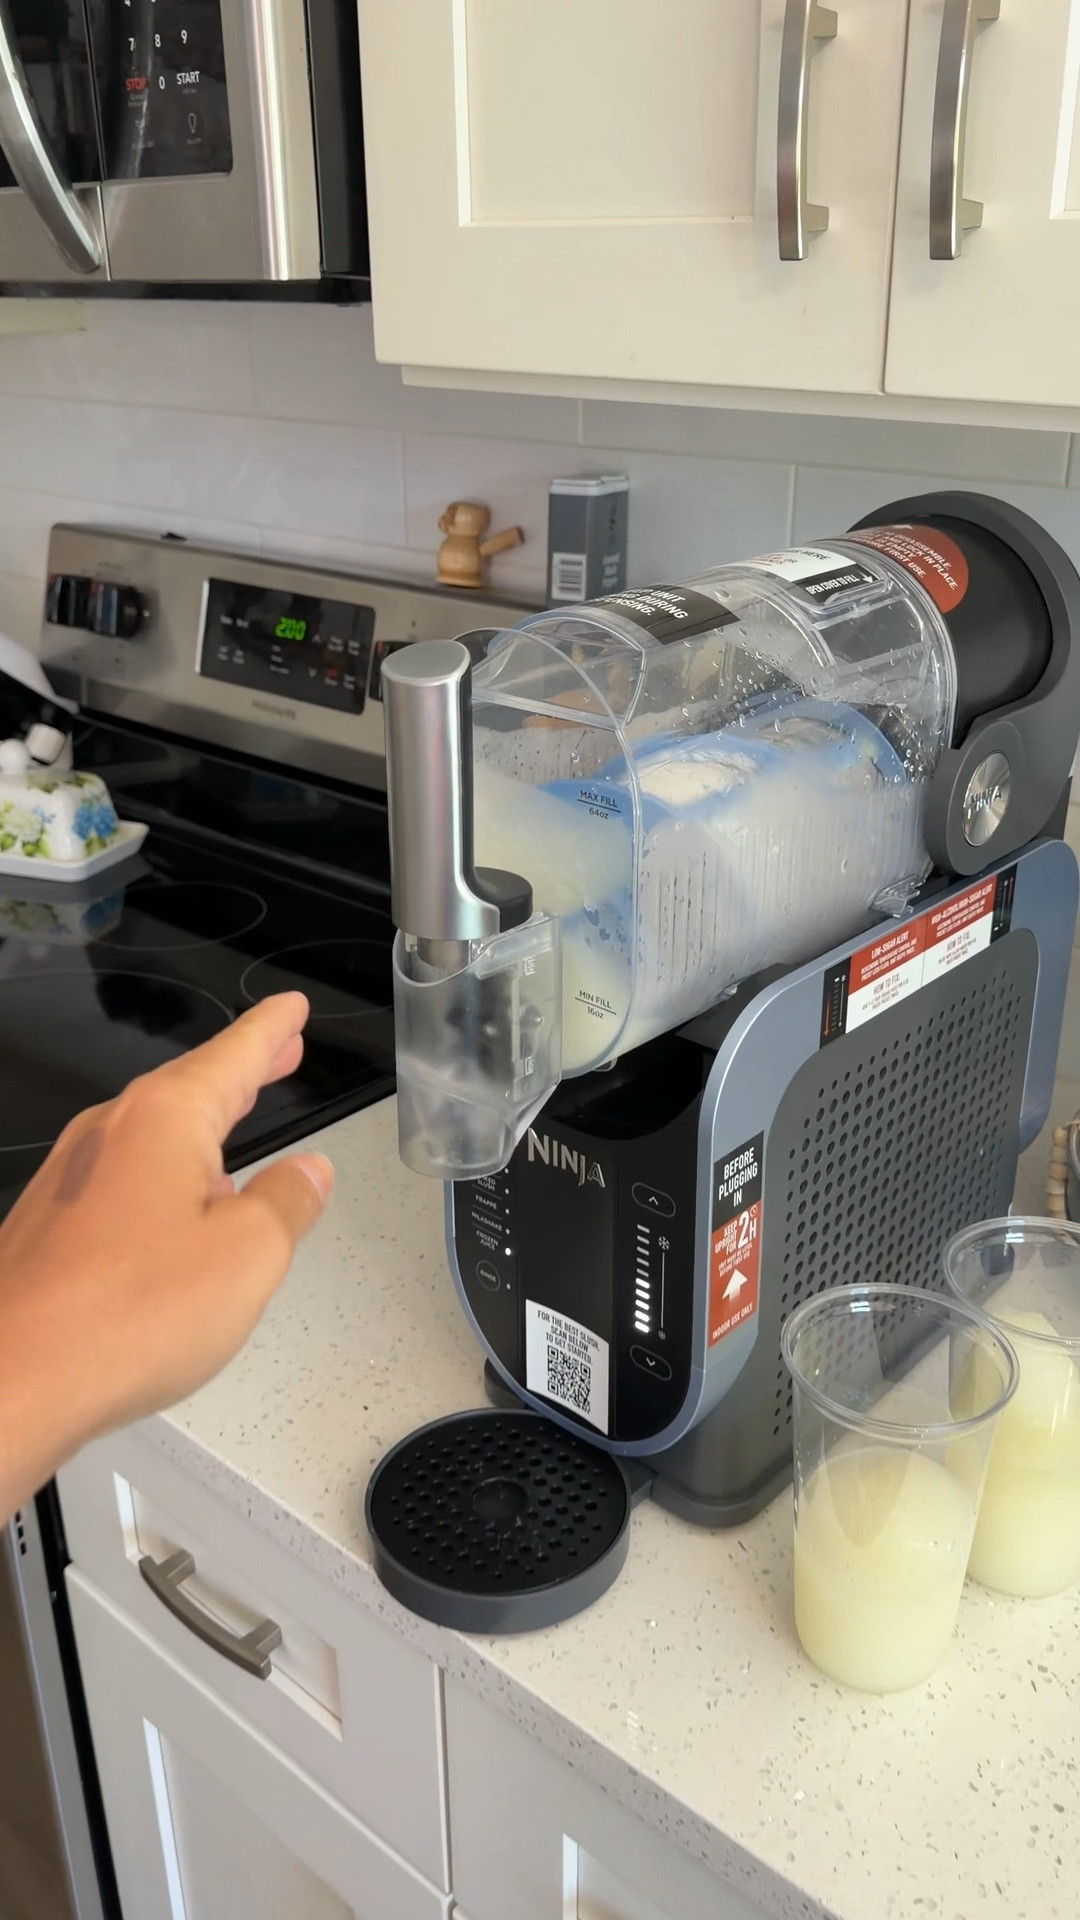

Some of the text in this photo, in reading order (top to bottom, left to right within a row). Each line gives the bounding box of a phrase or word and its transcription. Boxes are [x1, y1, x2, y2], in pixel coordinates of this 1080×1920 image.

[128, 29, 188, 51] 7 8 9
[125, 71, 200, 91] STOP 0 START
[884, 547, 911, 562] FIRST
[908, 562, 927, 579] USE.
[901, 541, 926, 557] LOCK
[922, 555, 936, 565] IN
[932, 562, 959, 591] PLACE.
[805, 584, 825, 595] OPEN
[821, 580, 841, 592] COVER
[845, 574, 860, 585] FILL
[650, 590, 686, 602] UNIT
[636, 595, 689, 619] DURING
[580, 790, 618, 808] MAX FILL
[589, 807, 609, 820] 64oz
[896, 930, 909, 945] ALERT
[578, 990, 612, 1010] MIN FILL
[587, 1006, 604, 1019] 16oz
[527, 1127, 606, 1188] NINJA
[724, 1146, 754, 1180] BEFORE
[718, 1161, 758, 1201] PLUGGING
[733, 1188, 742, 1207] IN
[471, 1211, 503, 1232] MILKSHAKE
[724, 1220, 738, 1238] KEEP
[476, 1230, 499, 1247] FROZEN
[480, 1239, 495, 1251] JUICE
[714, 1230, 737, 1254] UPRIGHT
[726, 1240, 737, 1256] FOR
[537, 1309, 551, 1323] FOR
[551, 1315, 563, 1328] THE
[564, 1321, 579, 1337] BEST
[712, 1302, 753, 1340] INDOOR USE ONLY
[546, 1331, 554, 1343] TO
[554, 1336, 566, 1349] GET
[550, 1324, 589, 1352] SCAN BELOW
